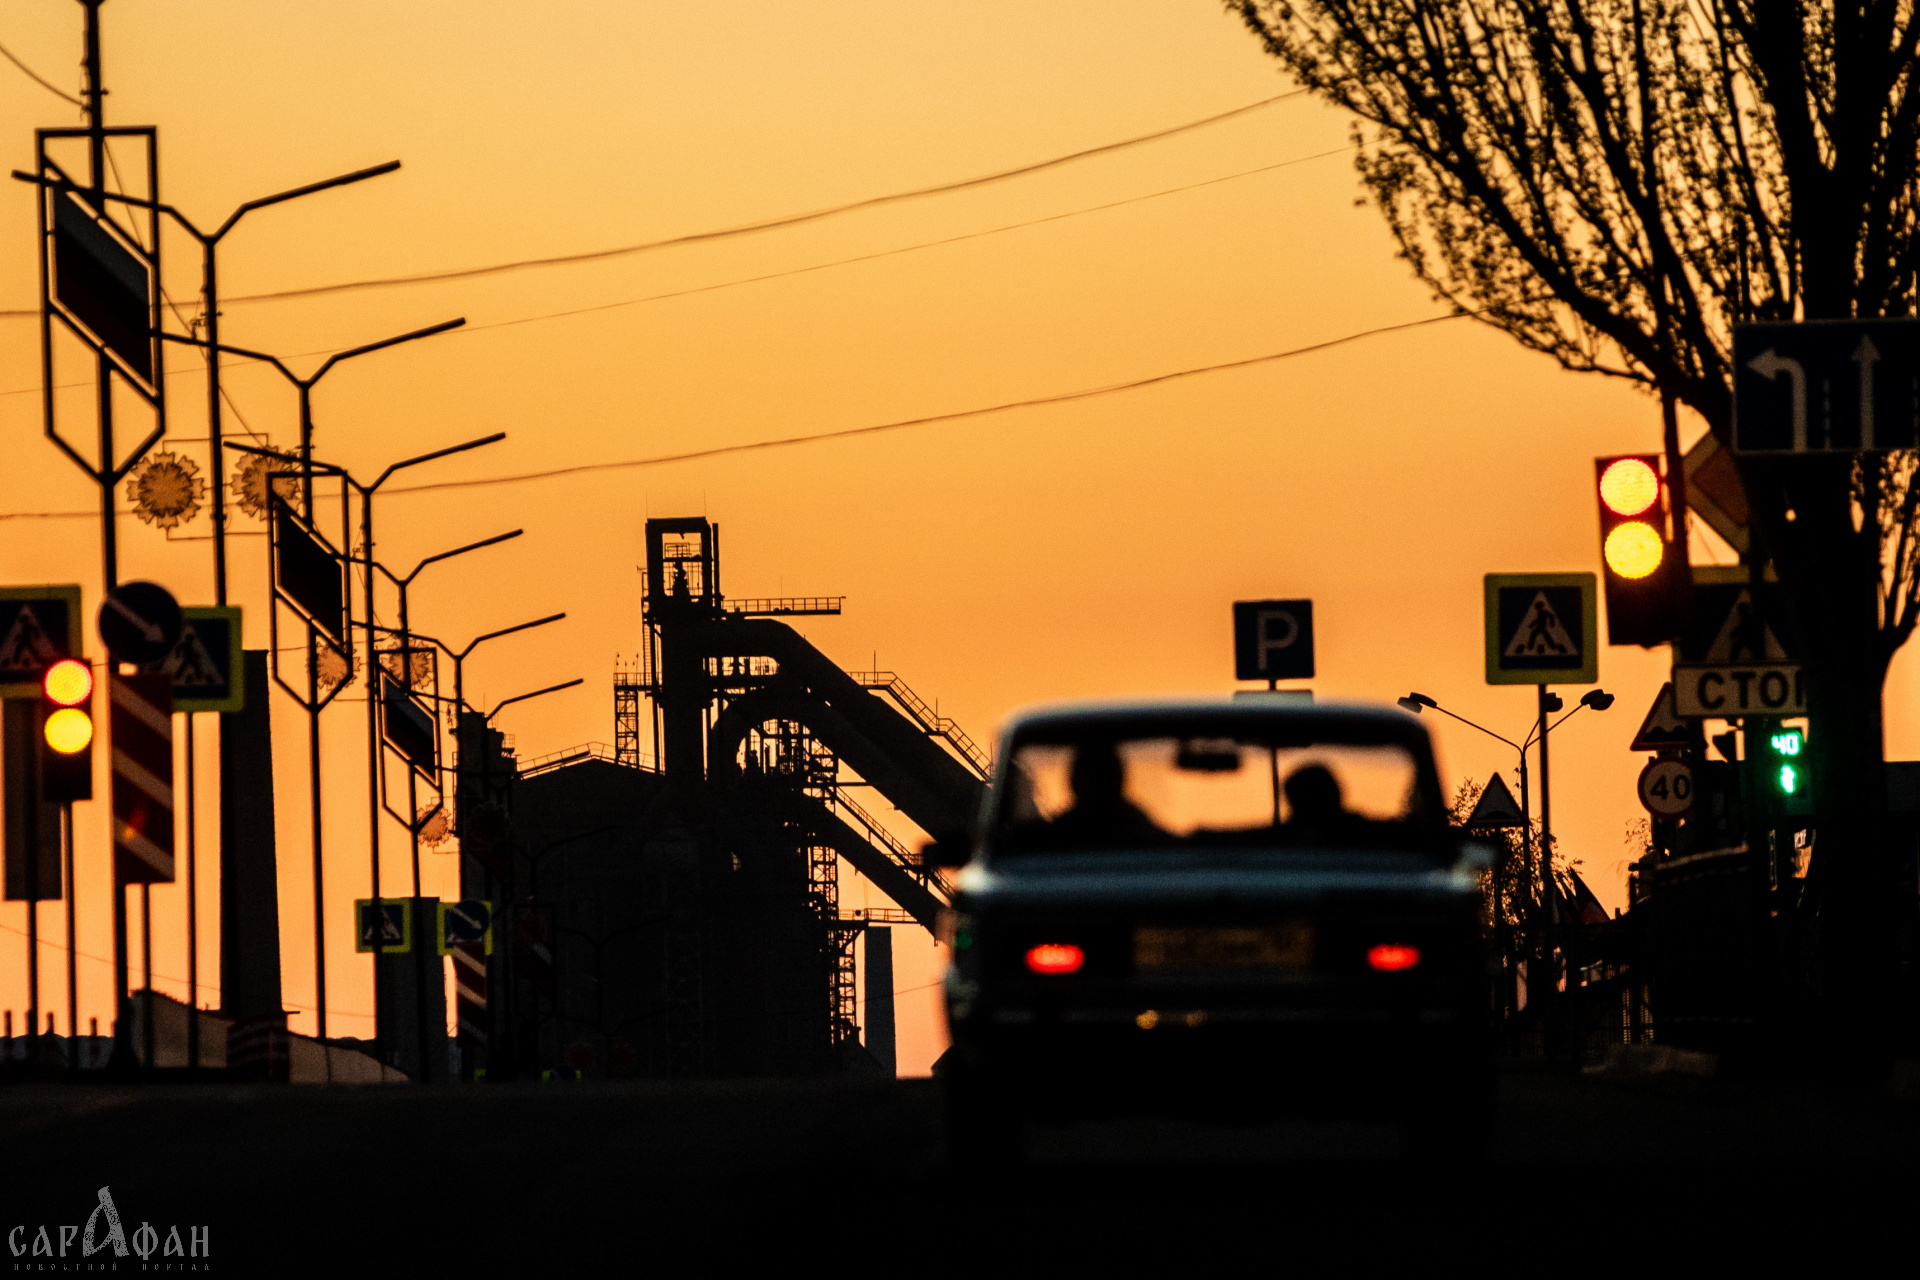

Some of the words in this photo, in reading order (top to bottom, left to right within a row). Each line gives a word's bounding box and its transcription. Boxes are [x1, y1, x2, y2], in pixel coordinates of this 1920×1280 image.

[1257, 609, 1299, 671] P
[1772, 733, 1800, 755] 40
[1651, 775, 1690, 800] 40
